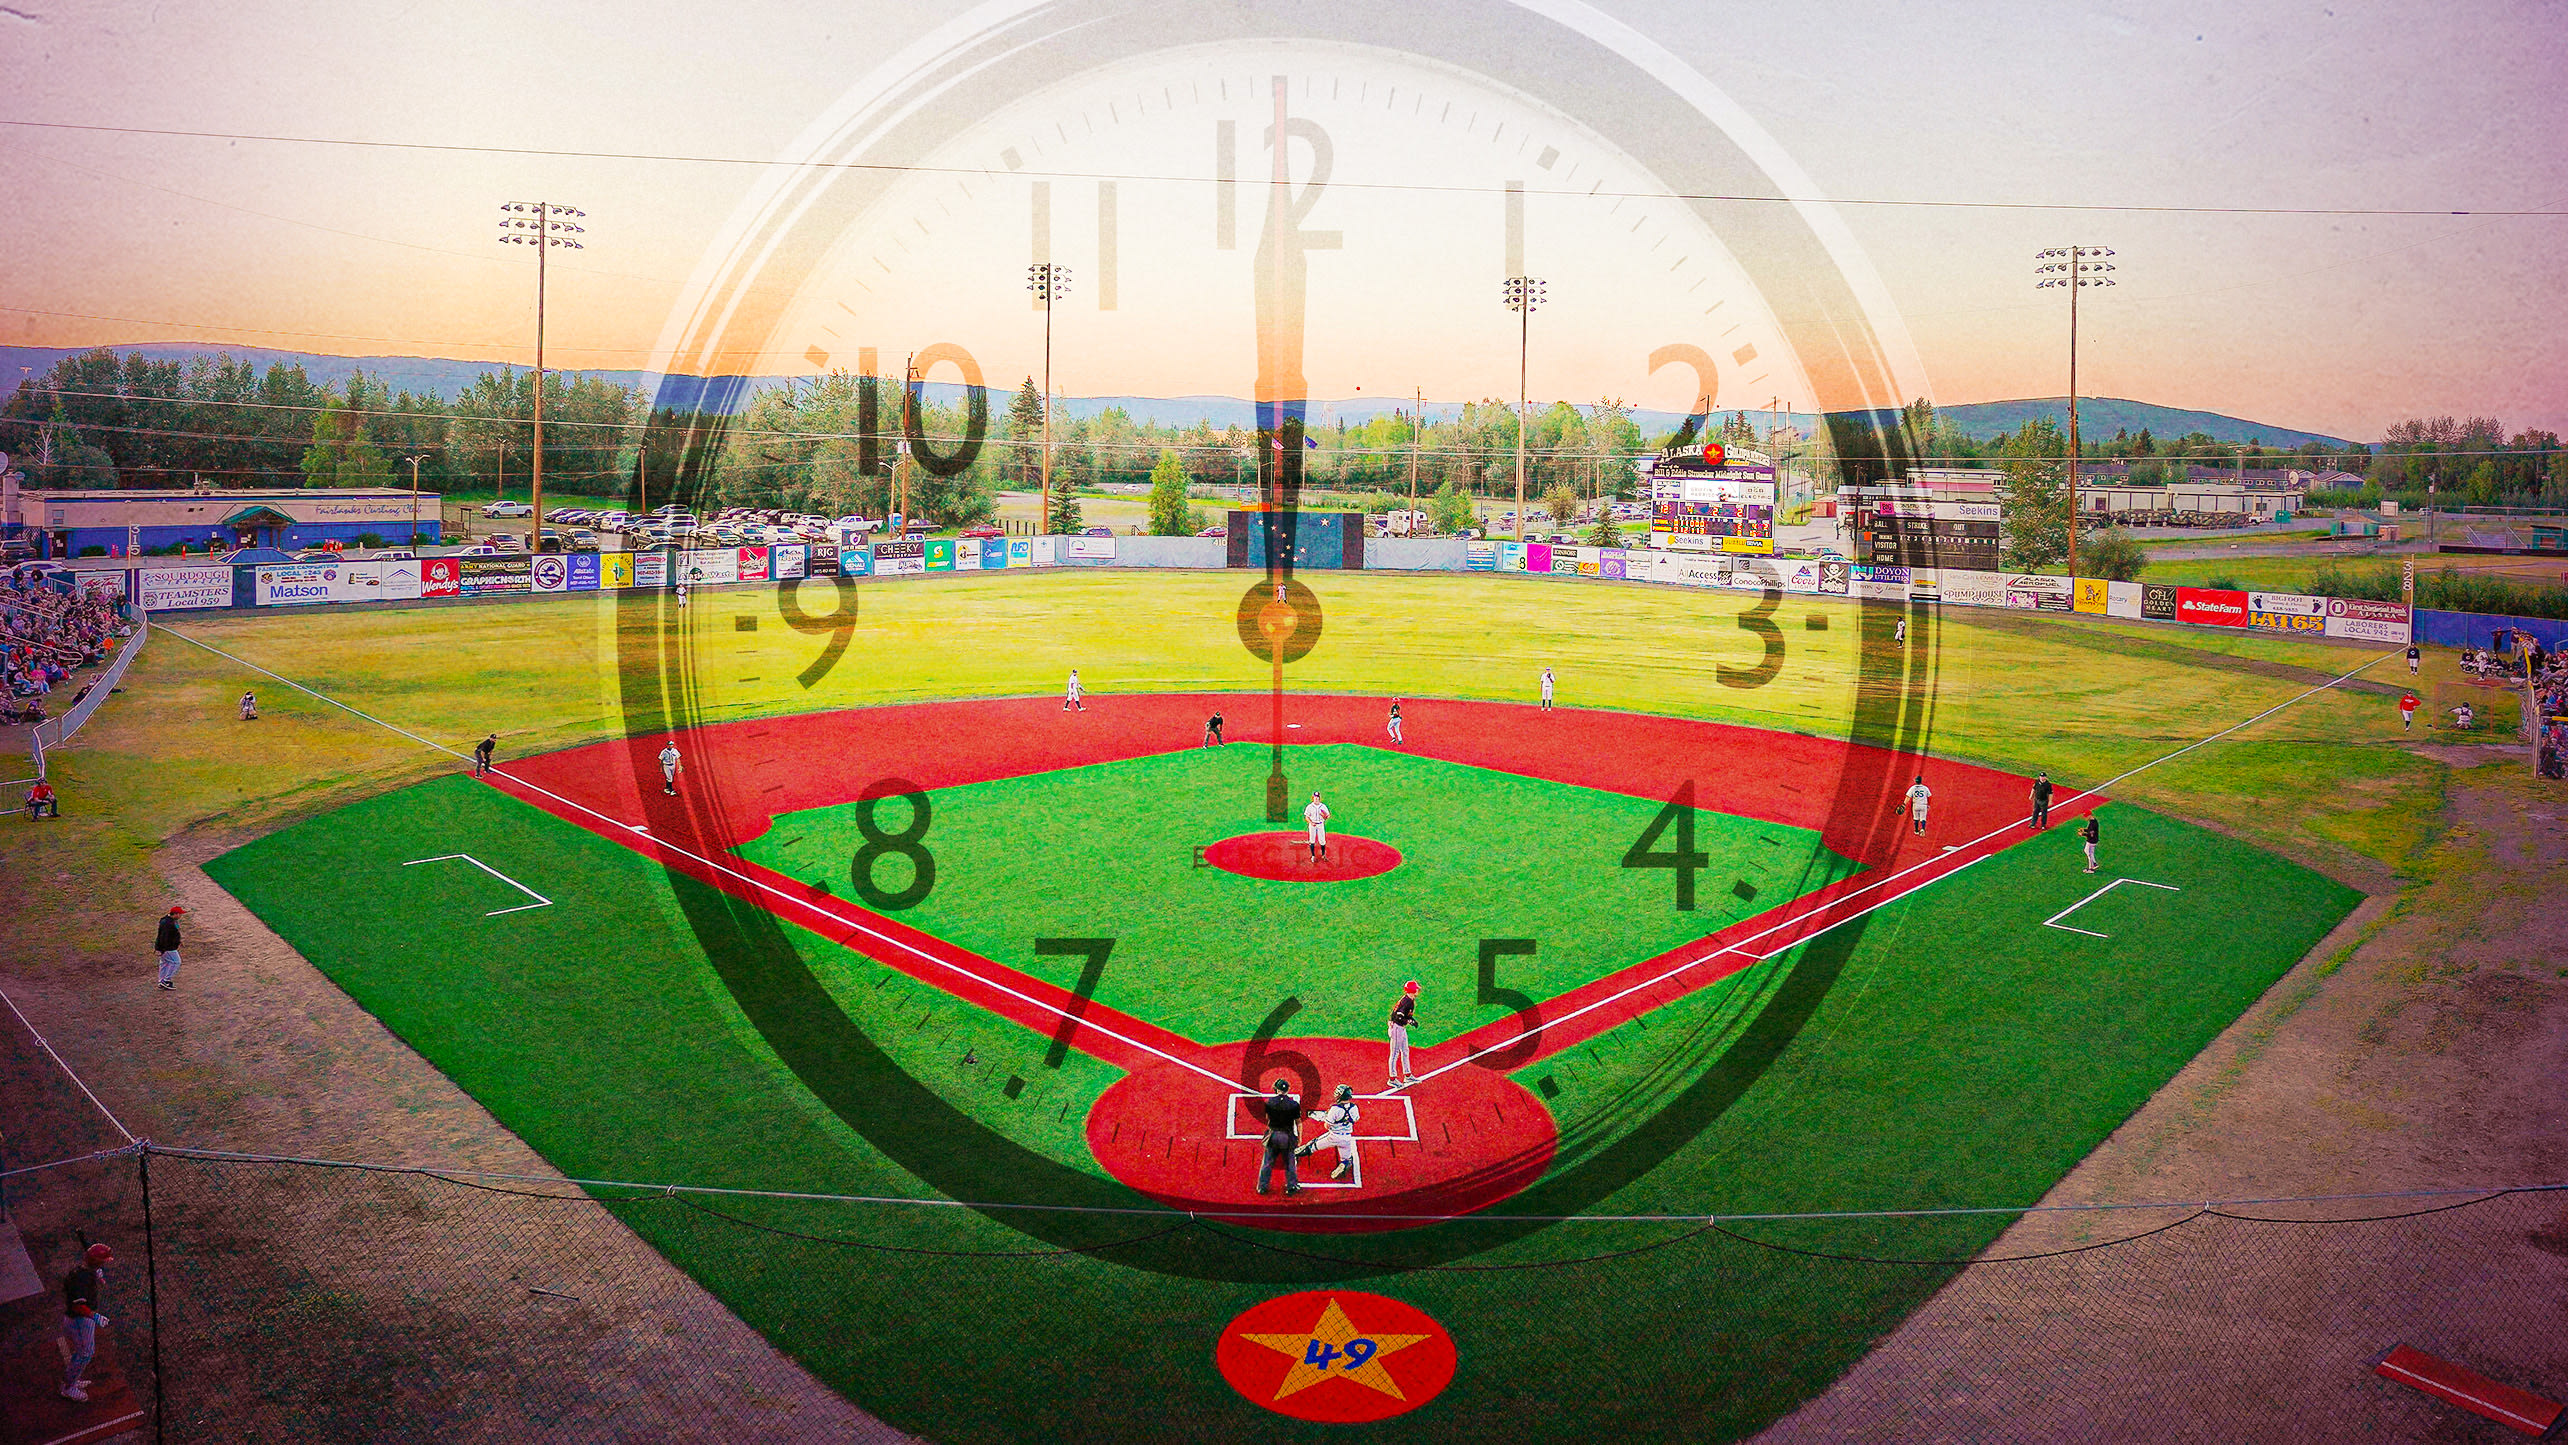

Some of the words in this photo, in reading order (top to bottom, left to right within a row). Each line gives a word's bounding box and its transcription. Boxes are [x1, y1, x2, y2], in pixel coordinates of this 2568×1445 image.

[1661, 443, 1704, 458] ALASKA
[315, 504, 361, 515] Fairbanks
[363, 503, 400, 517] Curling
[1959, 504, 1998, 516] Seekins
[130, 524, 141, 555] 315
[1212, 538, 1227, 546] 410
[1674, 536, 1704, 546] Seekins
[880, 544, 919, 554] CHEEKY
[1874, 541, 1897, 550] VISITOR
[817, 547, 834, 558] RJG
[1877, 554, 1894, 562] HOME
[154, 570, 230, 581] SOURDOUGH
[678, 572, 706, 580] Alaska
[707, 570, 736, 579] Waste
[1875, 566, 1910, 576] DOYON
[422, 577, 459, 593] Wendy's
[1734, 577, 1786, 588] ConocoPhillips
[1791, 575, 1816, 586] Coors
[158, 588, 229, 600] TEAMSTERS
[270, 585, 328, 598] Matson
[168, 598, 198, 607] Local
[200, 597, 220, 606] 959
[2349, 603, 2364, 611] First
[2358, 610, 2396, 619] ALASKA
[2345, 620, 2388, 630] LABORERS
[2344, 626, 2371, 635] LOCAL
[2373, 628, 2389, 636] 942
[1914, 790, 1925, 798] 35
[1303, 1338, 1378, 1370] 49
